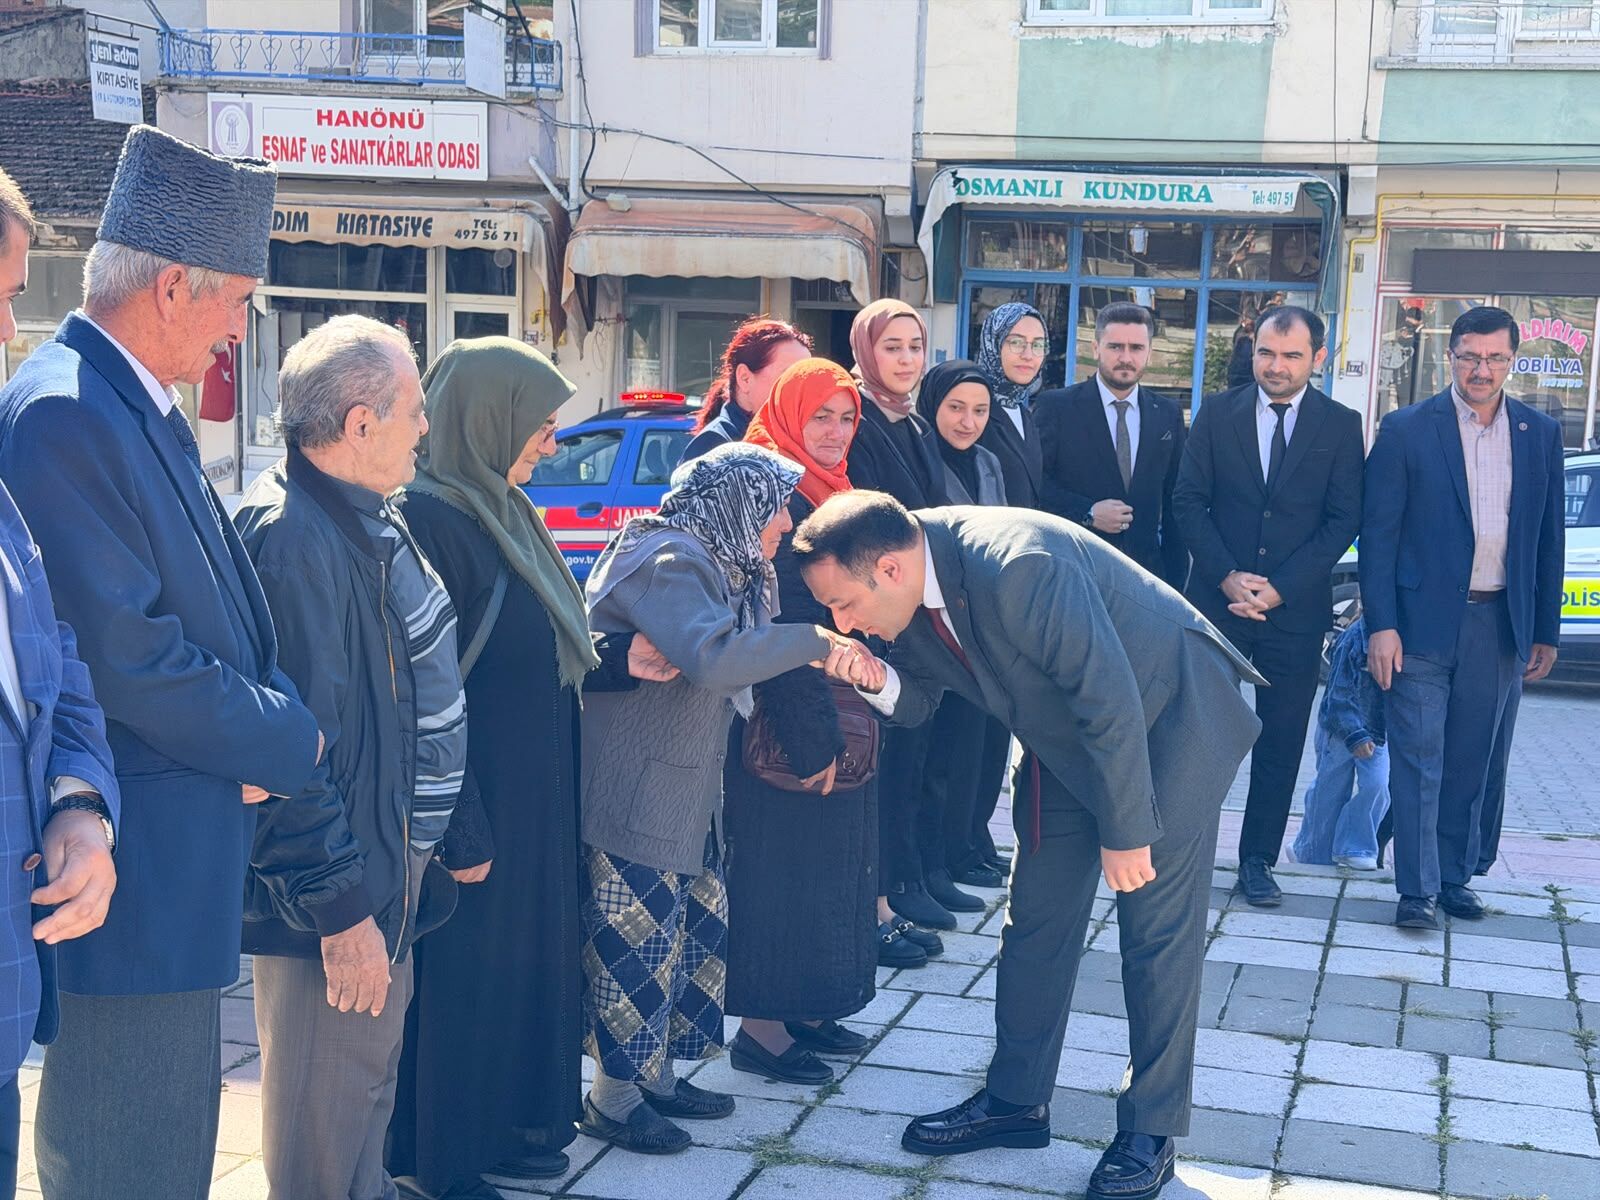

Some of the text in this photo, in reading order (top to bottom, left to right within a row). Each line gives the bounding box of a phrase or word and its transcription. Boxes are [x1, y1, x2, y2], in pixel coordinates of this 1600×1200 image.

[96, 71, 139, 91] KIRTASİYE
[317, 107, 424, 130] HANÖNÜ
[262, 134, 480, 170] ESNAF ve SANATKÂRLAR ODASI
[956, 178, 1213, 203] OSMANLI KUNDURA
[1252, 191, 1265, 205] Tel:
[1266, 192, 1281, 206] 497
[272, 211, 309, 233] DIM
[474, 219, 498, 230] TEL:
[454, 229, 518, 242] 497 56 71
[1520, 318, 1587, 355] LDIRIM
[1511, 354, 1583, 374] OBİLYA
[1560, 587, 1600, 607] OLİS
